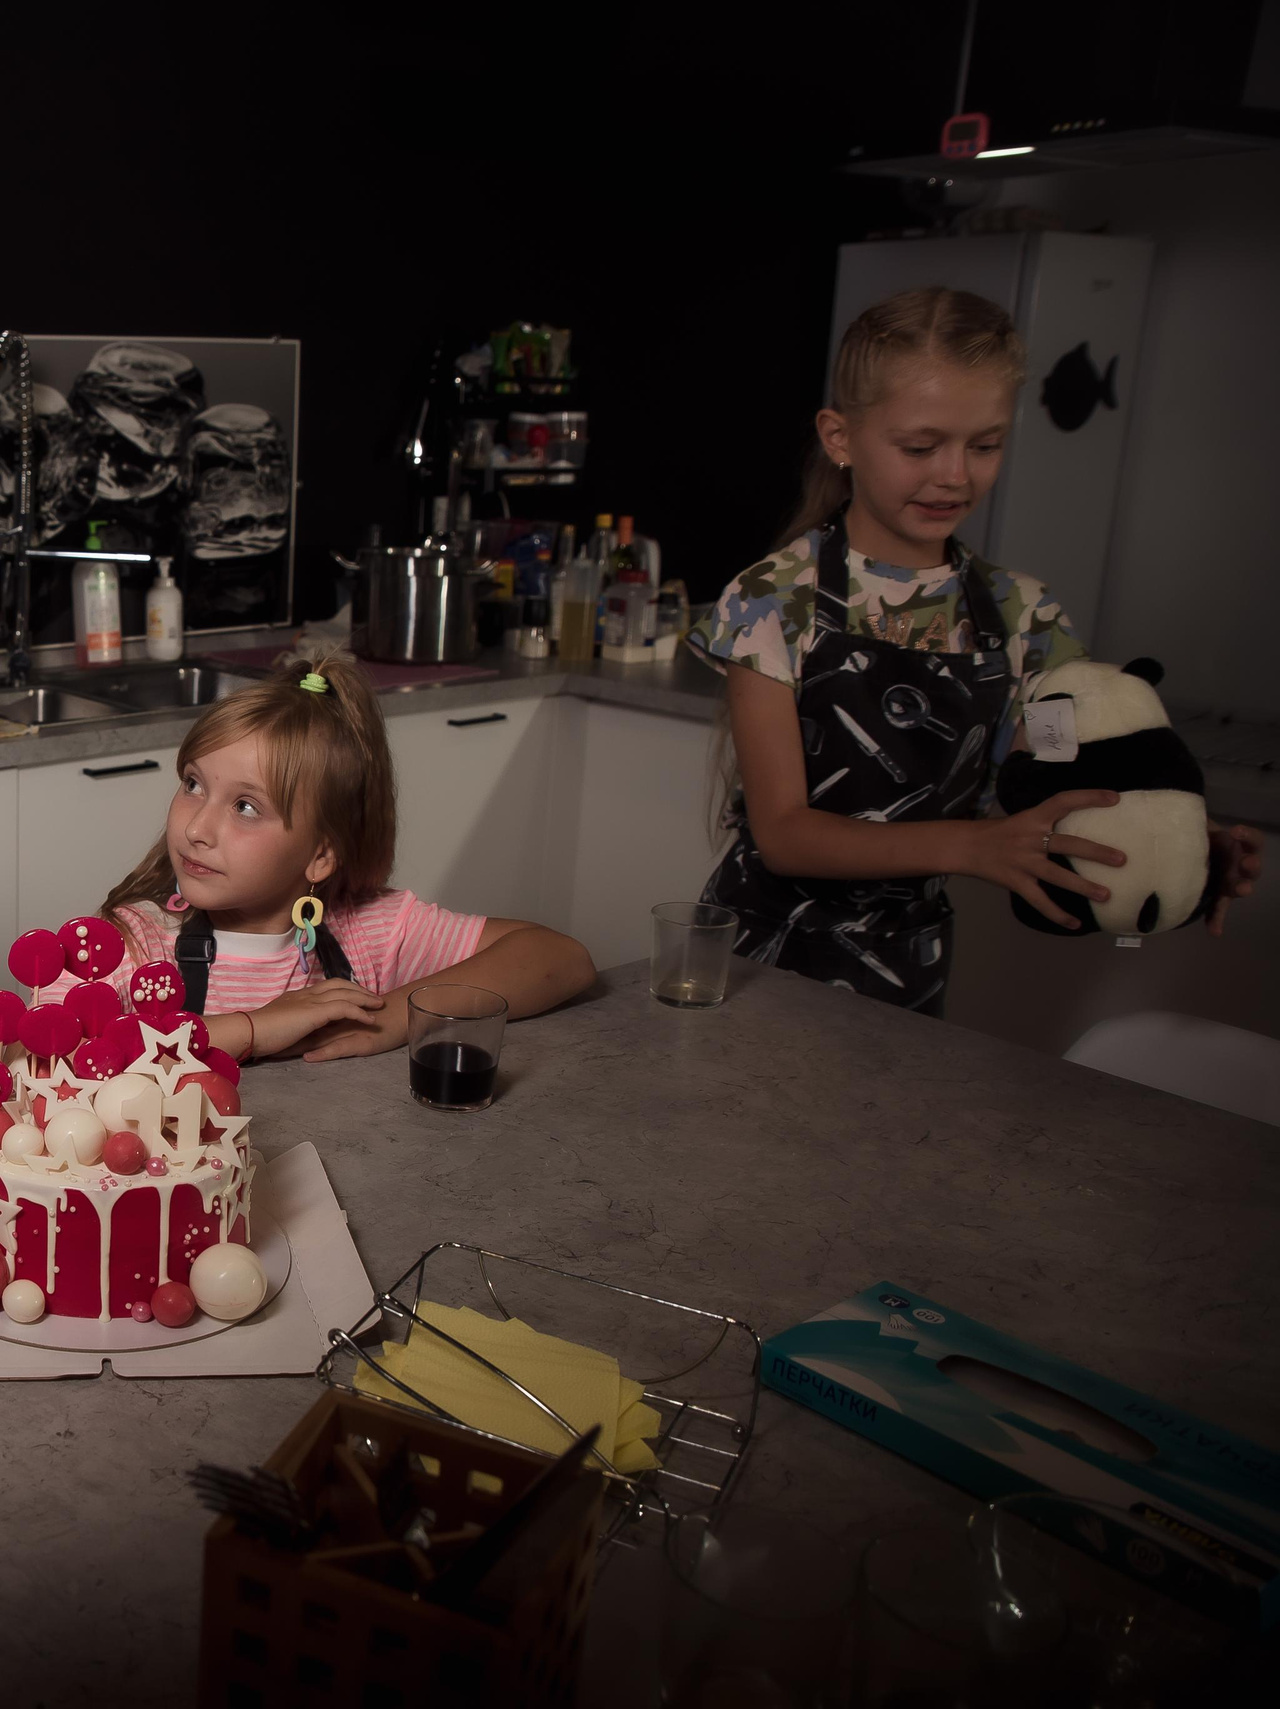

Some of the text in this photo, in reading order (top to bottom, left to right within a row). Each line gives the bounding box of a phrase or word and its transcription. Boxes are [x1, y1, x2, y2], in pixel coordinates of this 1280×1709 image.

[121, 1082, 203, 1160] 11
[916, 1310, 941, 1323] 100
[772, 1355, 878, 1422] ПЕРЧАТКИ
